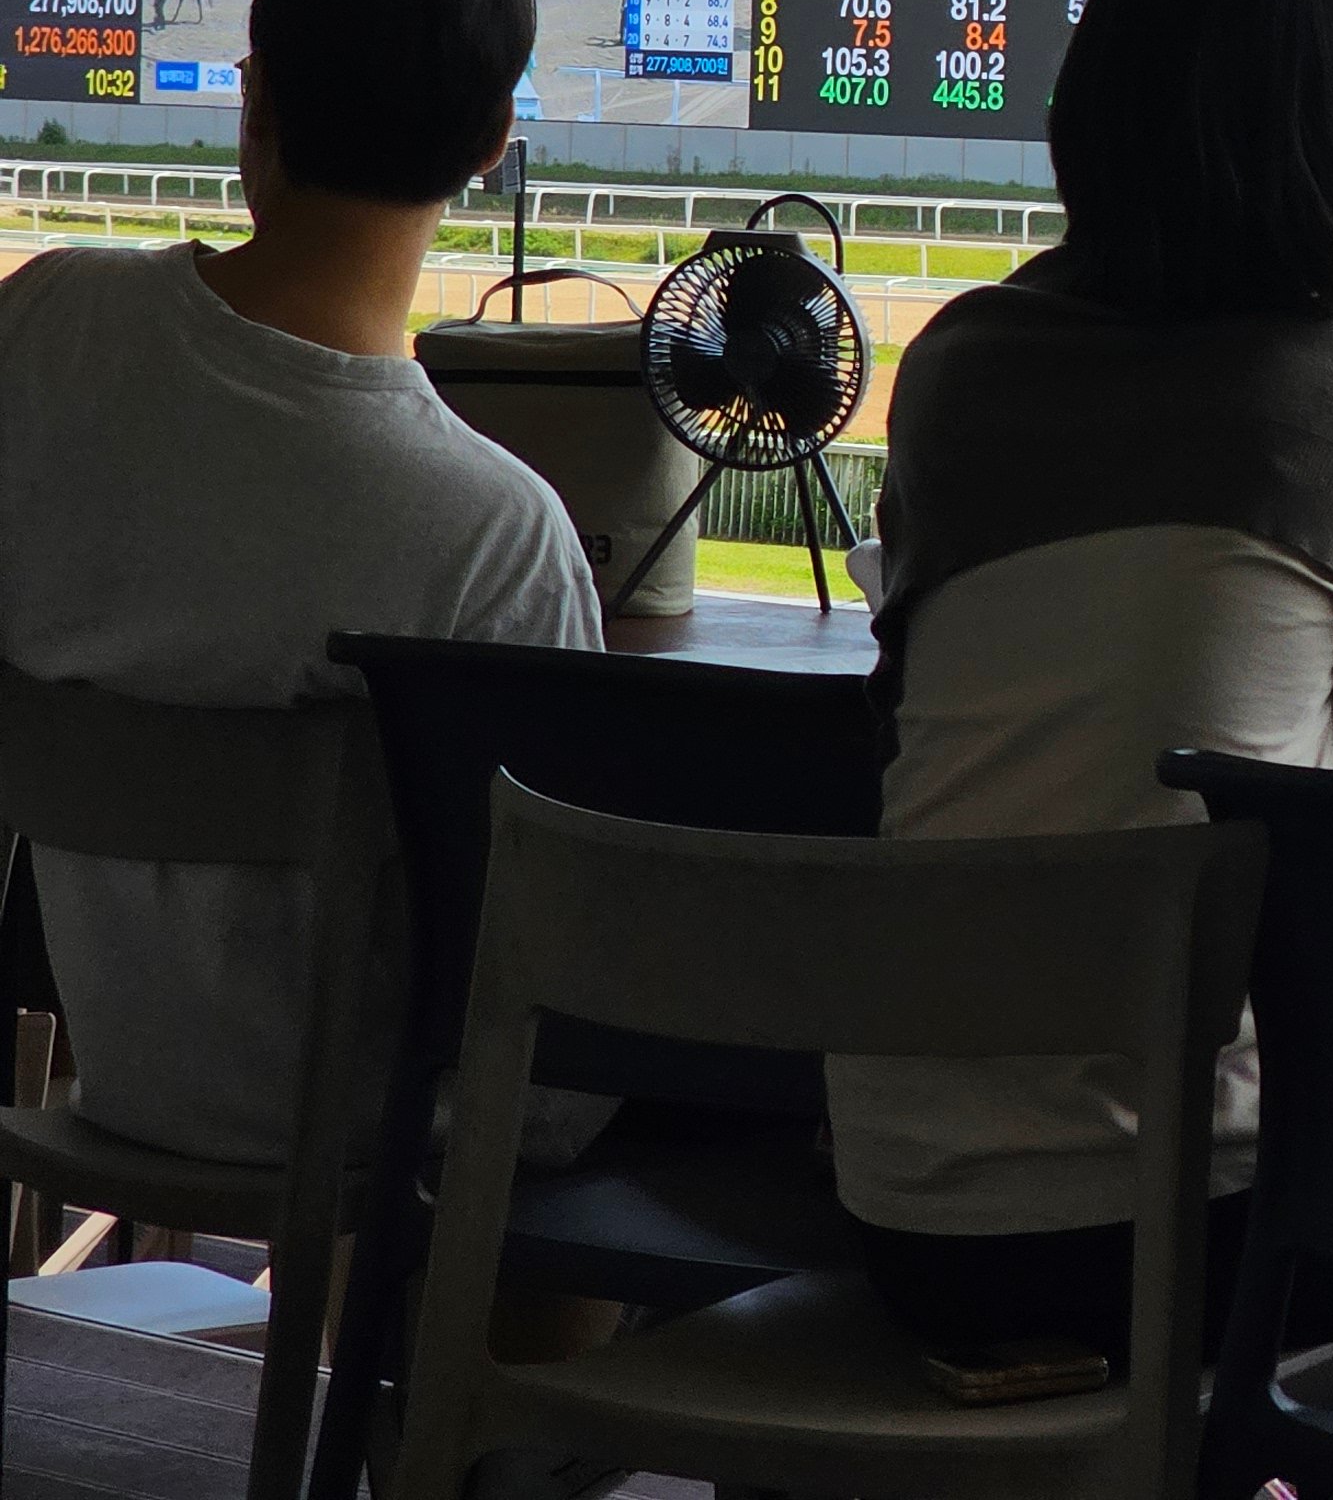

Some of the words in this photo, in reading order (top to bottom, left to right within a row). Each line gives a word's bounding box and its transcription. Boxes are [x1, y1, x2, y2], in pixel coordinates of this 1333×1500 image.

[15, 27, 135, 58] 1,276,266,300
[707, 34, 728, 48] 74.3
[853, 19, 891, 47] 7.5
[966, 22, 1006, 50] 8.4
[86, 69, 134, 96] 10:32
[208, 68, 234, 86] 2:50
[820, 76, 888, 105] 407.0
[933, 80, 1003, 110] 445.8
